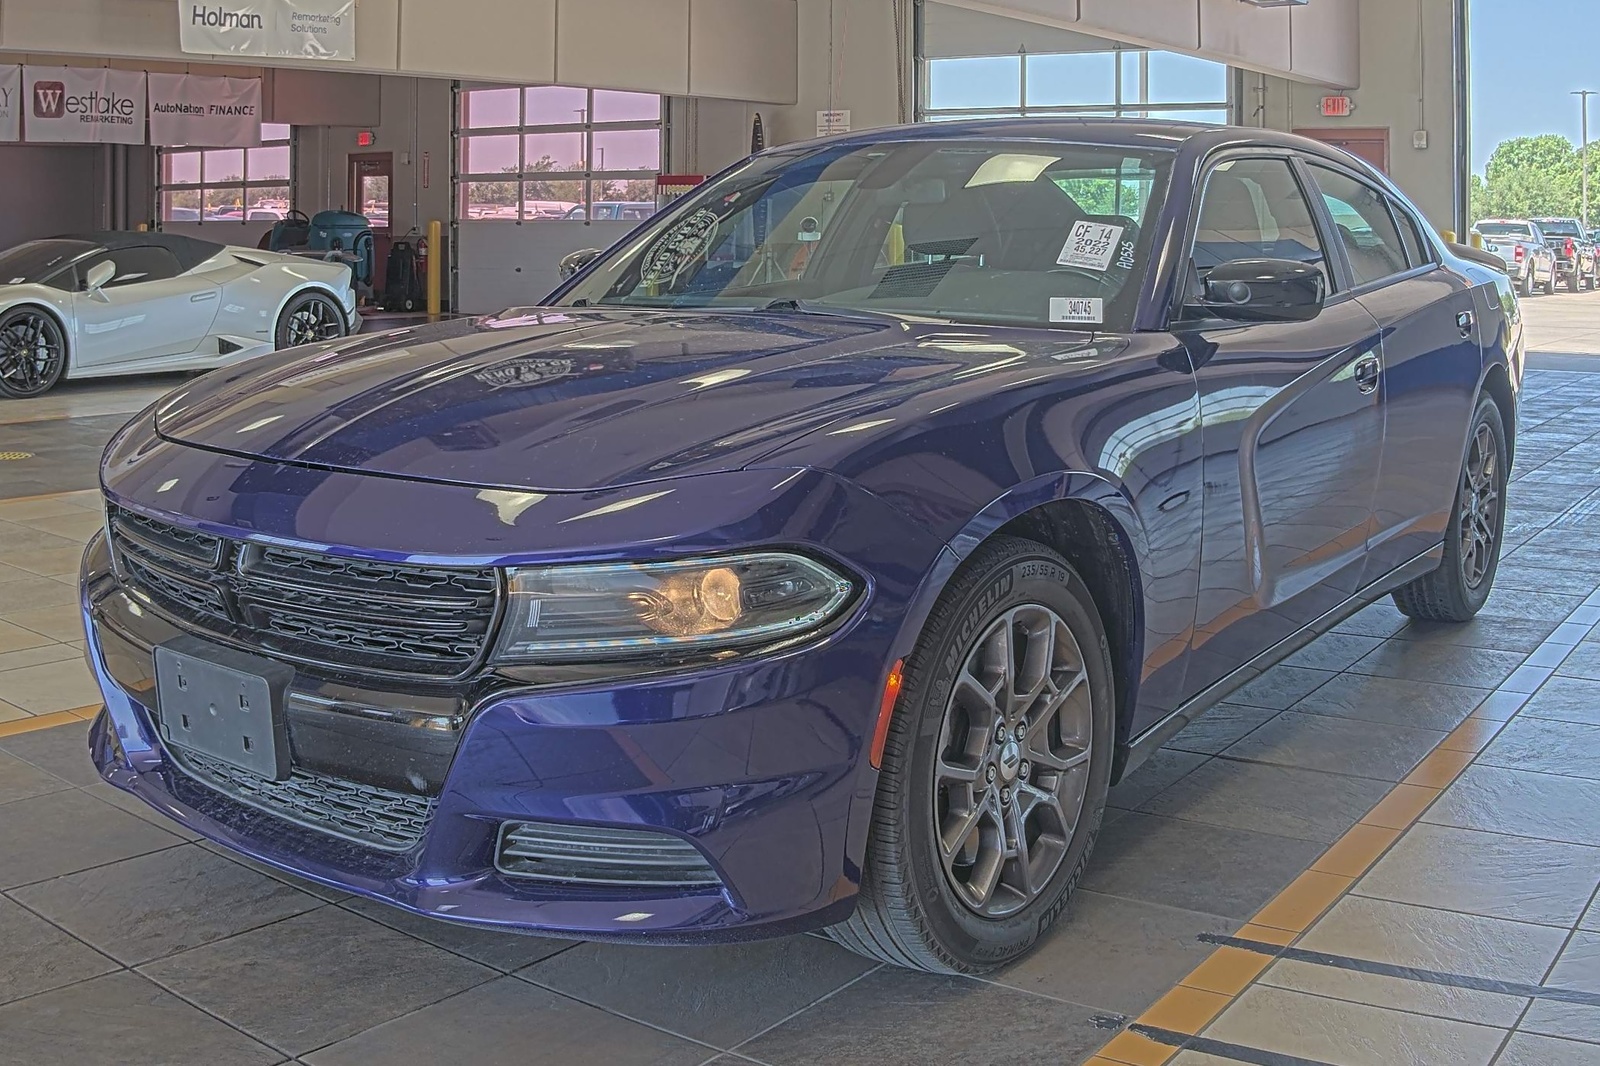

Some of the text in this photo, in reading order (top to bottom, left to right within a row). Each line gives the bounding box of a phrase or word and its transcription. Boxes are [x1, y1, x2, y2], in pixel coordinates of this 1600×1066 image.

[192, 5, 263, 30] Holman
[290, 24, 328, 34] Solutions
[0, 87, 14, 107] Y
[36, 88, 134, 115] Westlake
[1325, 97, 1345, 114] EXIT
[153, 103, 255, 116] AutoNation FINANCE
[80, 115, 133, 125] REMARKETING
[1075, 224, 1113, 241] CF 14
[1075, 237, 1110, 249] 2022
[1068, 300, 1092, 315] 340745
[1021, 564, 1066, 582] 235/55 R 19
[944, 573, 1011, 675] MICHELIN
[1038, 835, 1096, 936] MICHELIN
